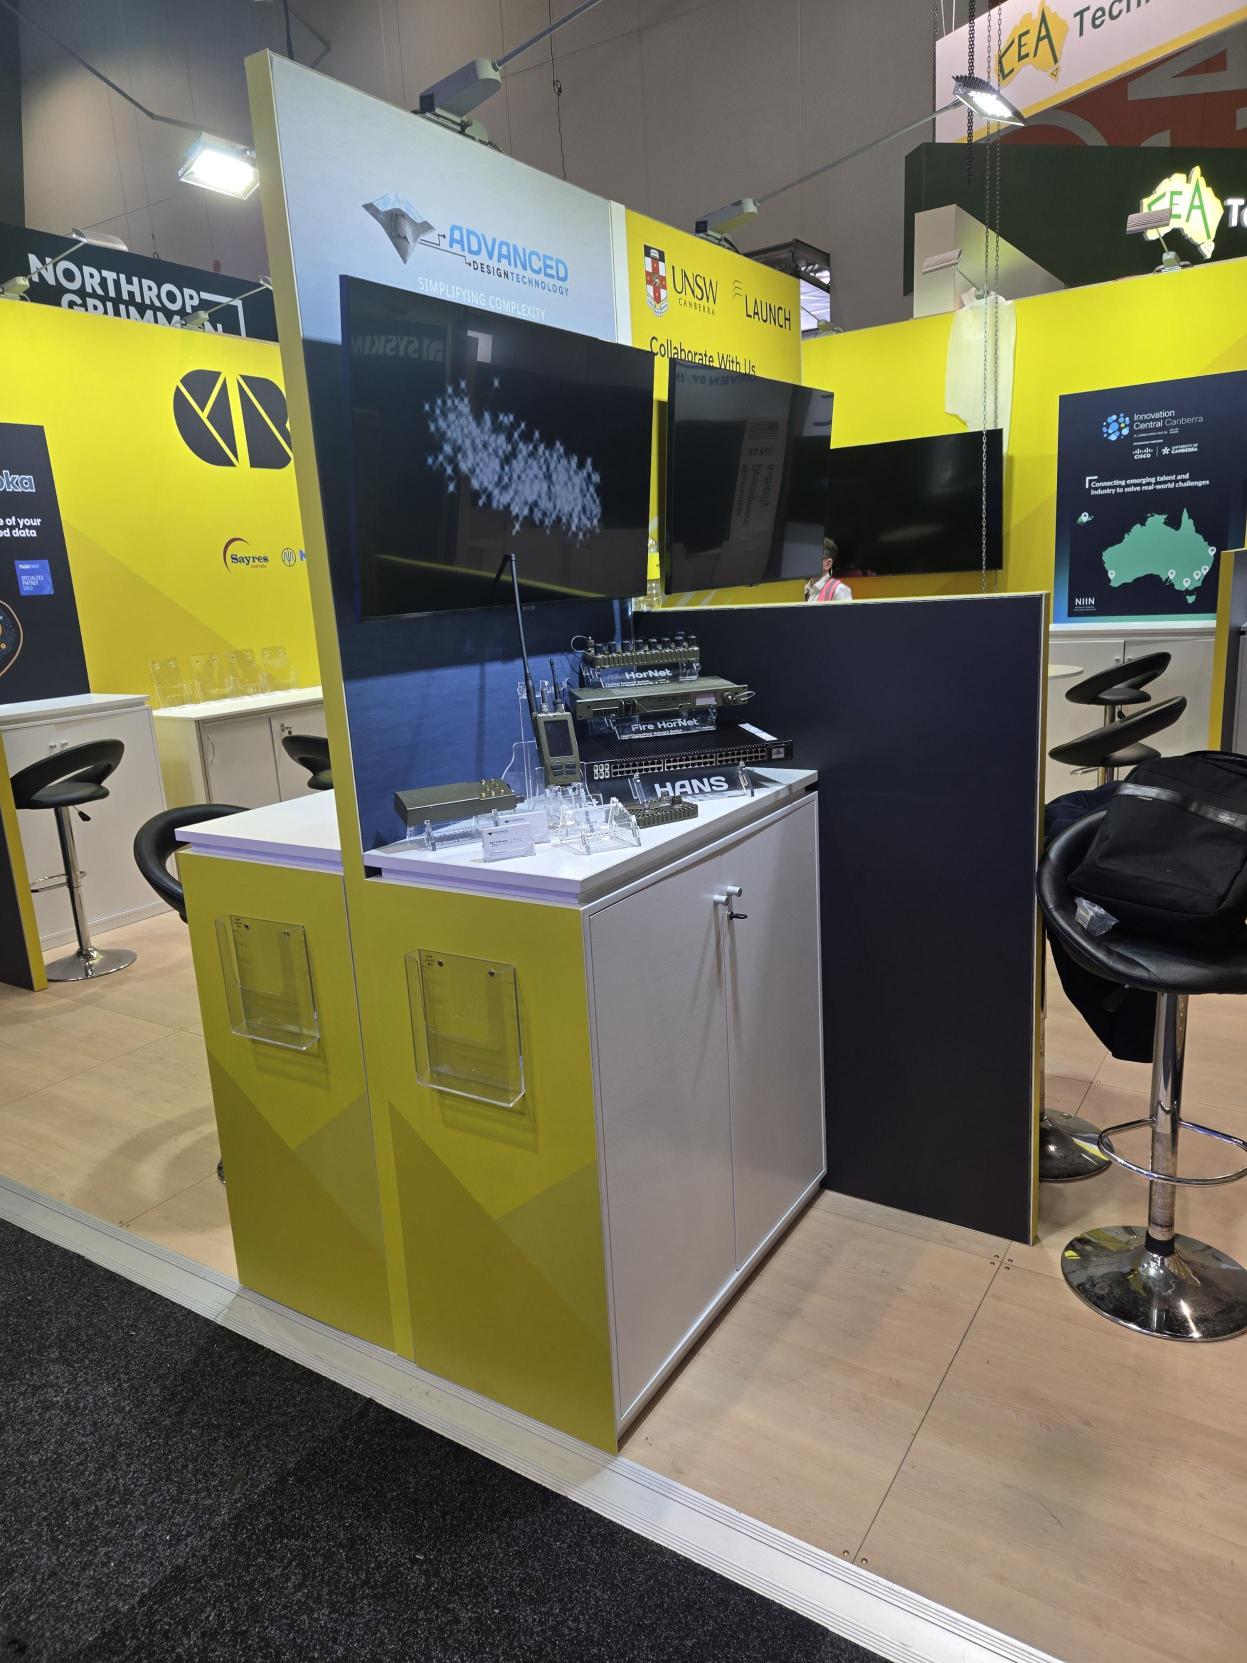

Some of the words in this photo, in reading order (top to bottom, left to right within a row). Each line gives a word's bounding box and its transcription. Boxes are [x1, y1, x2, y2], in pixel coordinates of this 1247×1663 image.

[998, 8, 1059, 81] CEA
[449, 224, 569, 282] ADVANCED
[28, 253, 200, 313] NORTHROP
[473, 260, 569, 297] DESIGNTECHNOLOGY
[672, 265, 718, 305] UNSW
[417, 276, 487, 307] SIMPLIFYING
[489, 295, 546, 321] COMPLEXITY
[678, 297, 716, 317] CANBERRA
[745, 294, 792, 331] LAUNCH
[650, 336, 714, 367] Collaborate
[717, 351, 741, 373] With
[744, 358, 756, 376] Us
[1133, 419, 1163, 430] Central
[1164, 416, 1204, 427] Canberra
[1134, 410, 1175, 421] Innovation
[1090, 486, 1115, 495] industry
[1124, 484, 1141, 492] solve
[1142, 480, 1174, 490] real-world
[1175, 479, 1210, 488] challenges
[1091, 479, 1126, 488] Connecting
[1126, 476, 1156, 485] emerging
[1157, 473, 1175, 481] talent
[1176, 472, 1189, 480] and
[5, 516, 16, 526] of
[17, 518, 42, 528] your
[12, 528, 37, 537] data
[230, 553, 269, 566] Sayres
[1075, 597, 1095, 605] NIIN
[625, 668, 673, 680] HorNet
[631, 722, 655, 732] Fire
[657, 718, 699, 730] HorNet
[654, 776, 729, 798] HANS
